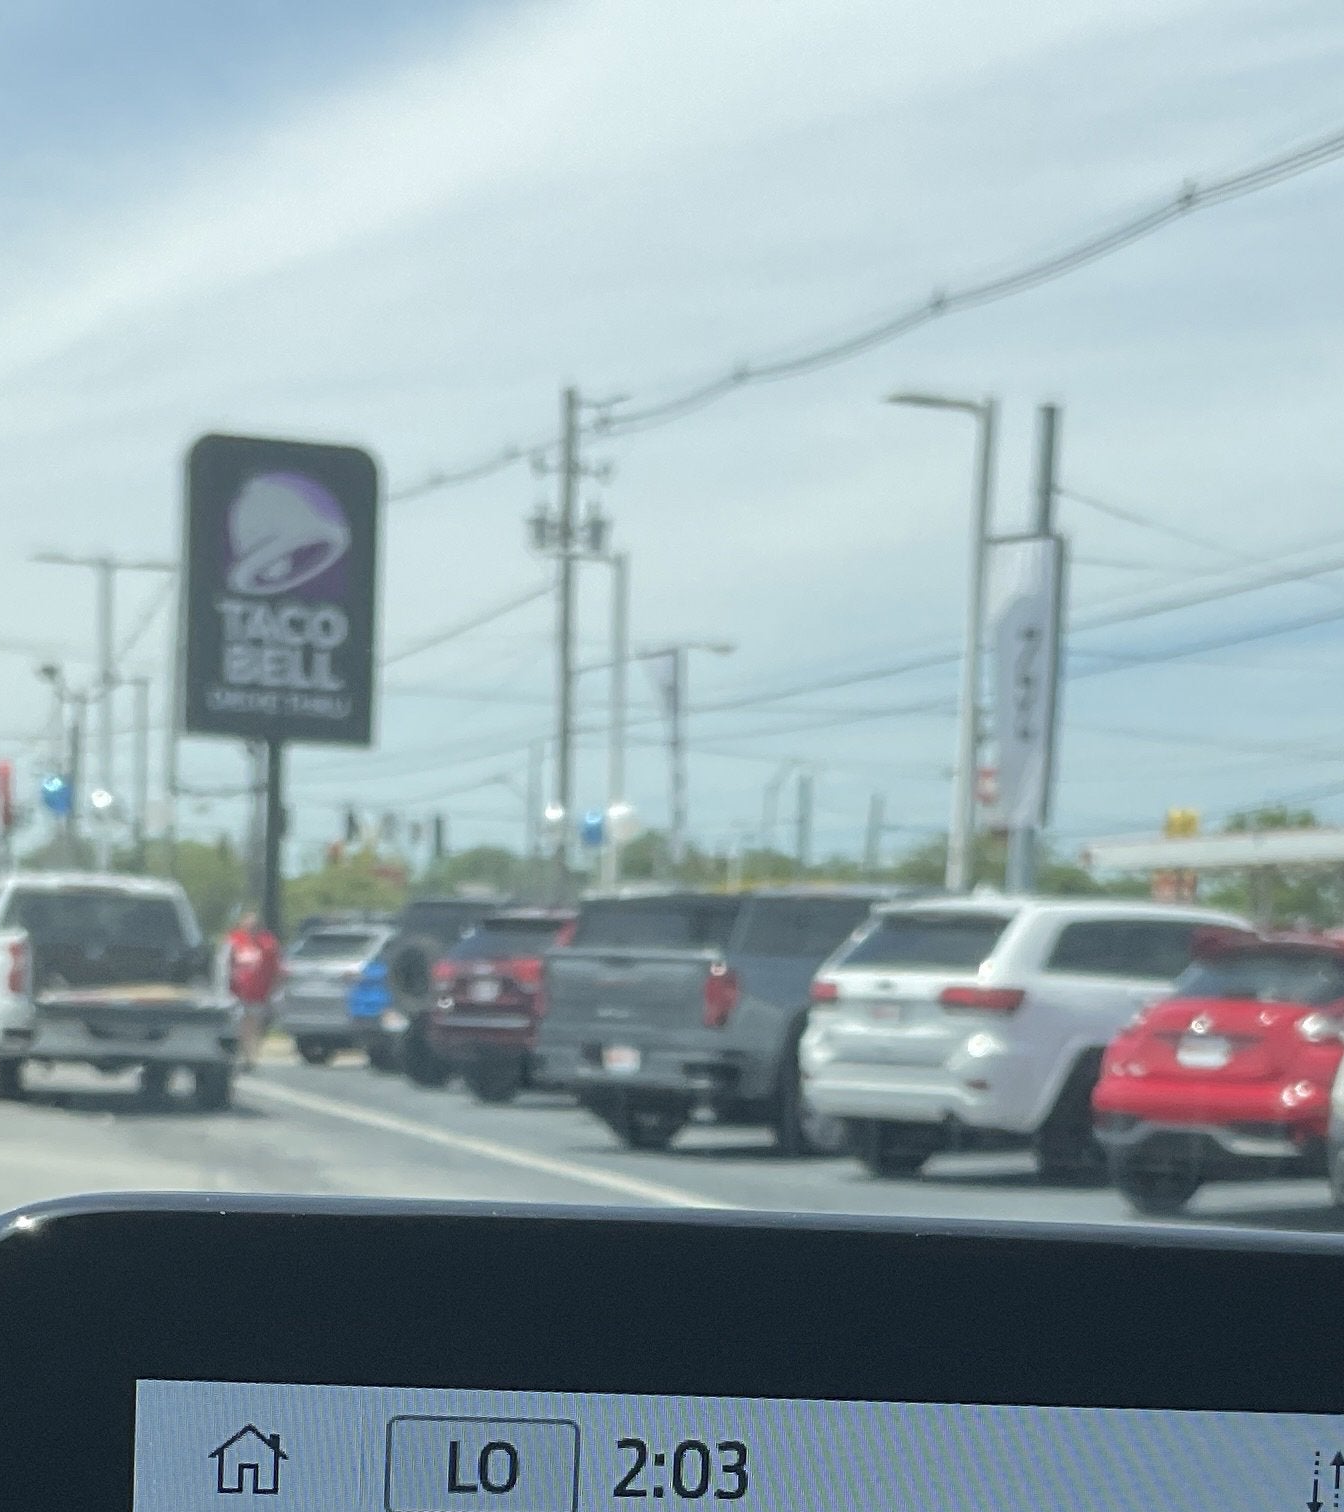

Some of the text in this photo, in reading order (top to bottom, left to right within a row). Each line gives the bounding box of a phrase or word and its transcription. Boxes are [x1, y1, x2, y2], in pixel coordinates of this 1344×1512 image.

[215, 600, 348, 649] TACO
[224, 645, 344, 691] BELL
[446, 1440, 520, 1496] LO
[613, 1437, 750, 1501] 2:03
